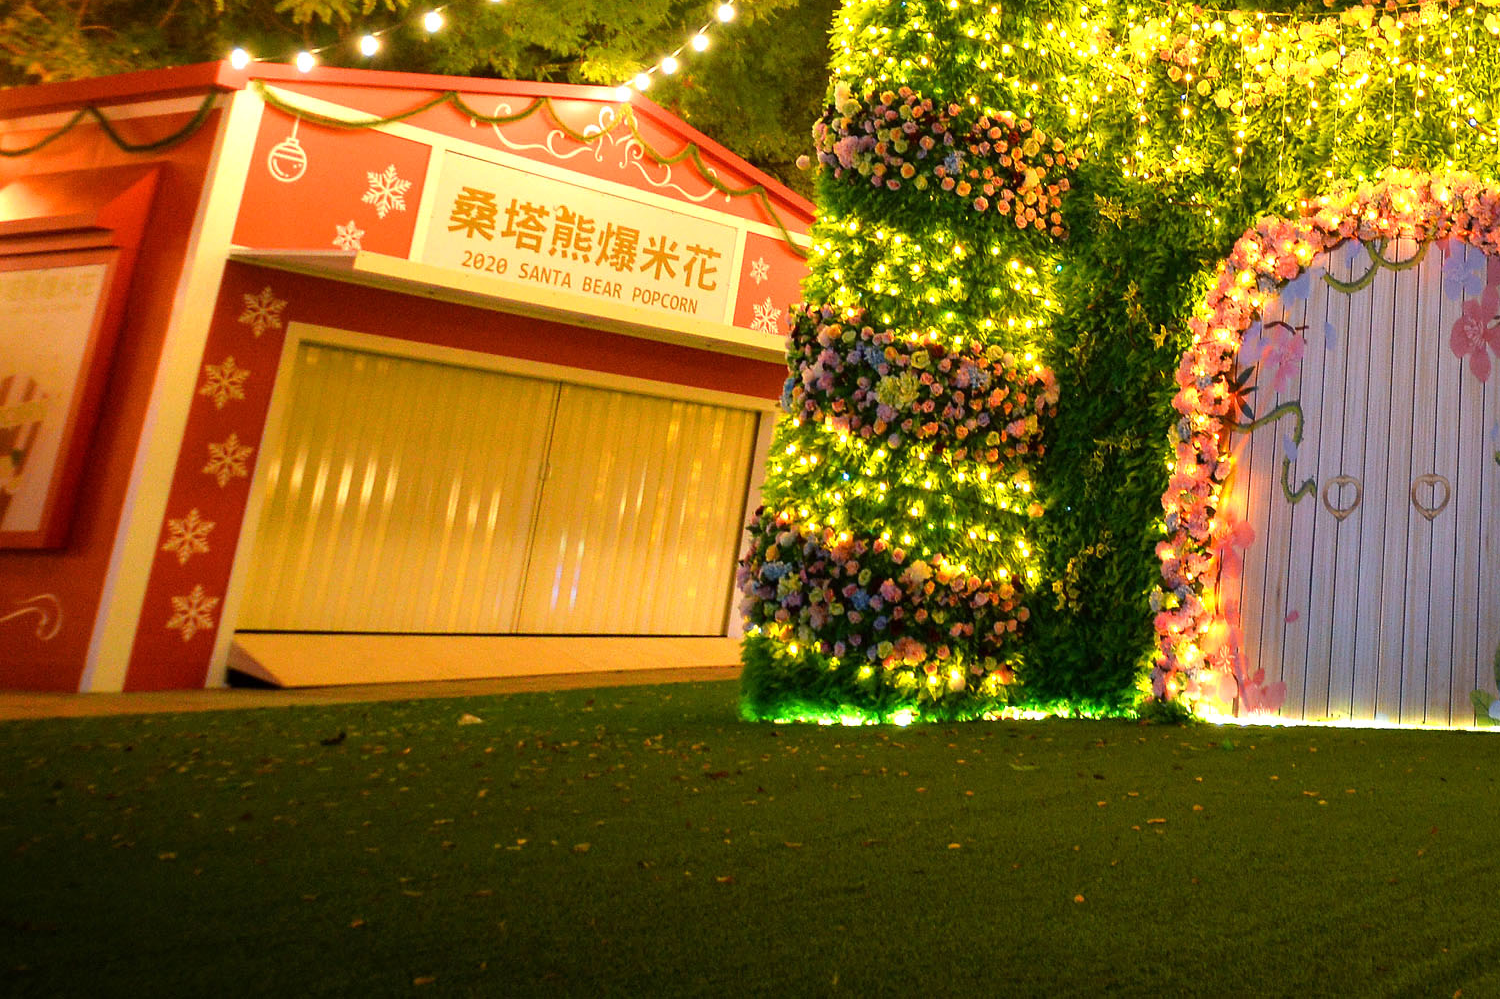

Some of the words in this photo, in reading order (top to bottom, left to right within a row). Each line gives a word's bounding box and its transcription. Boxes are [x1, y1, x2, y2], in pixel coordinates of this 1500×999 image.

[448, 186, 722, 292] 桑塔熊爆米花
[461, 250, 508, 274] 2020
[518, 262, 571, 288] SANTA
[582, 276, 622, 299] BEAR
[632, 287, 698, 314] POPCORN
